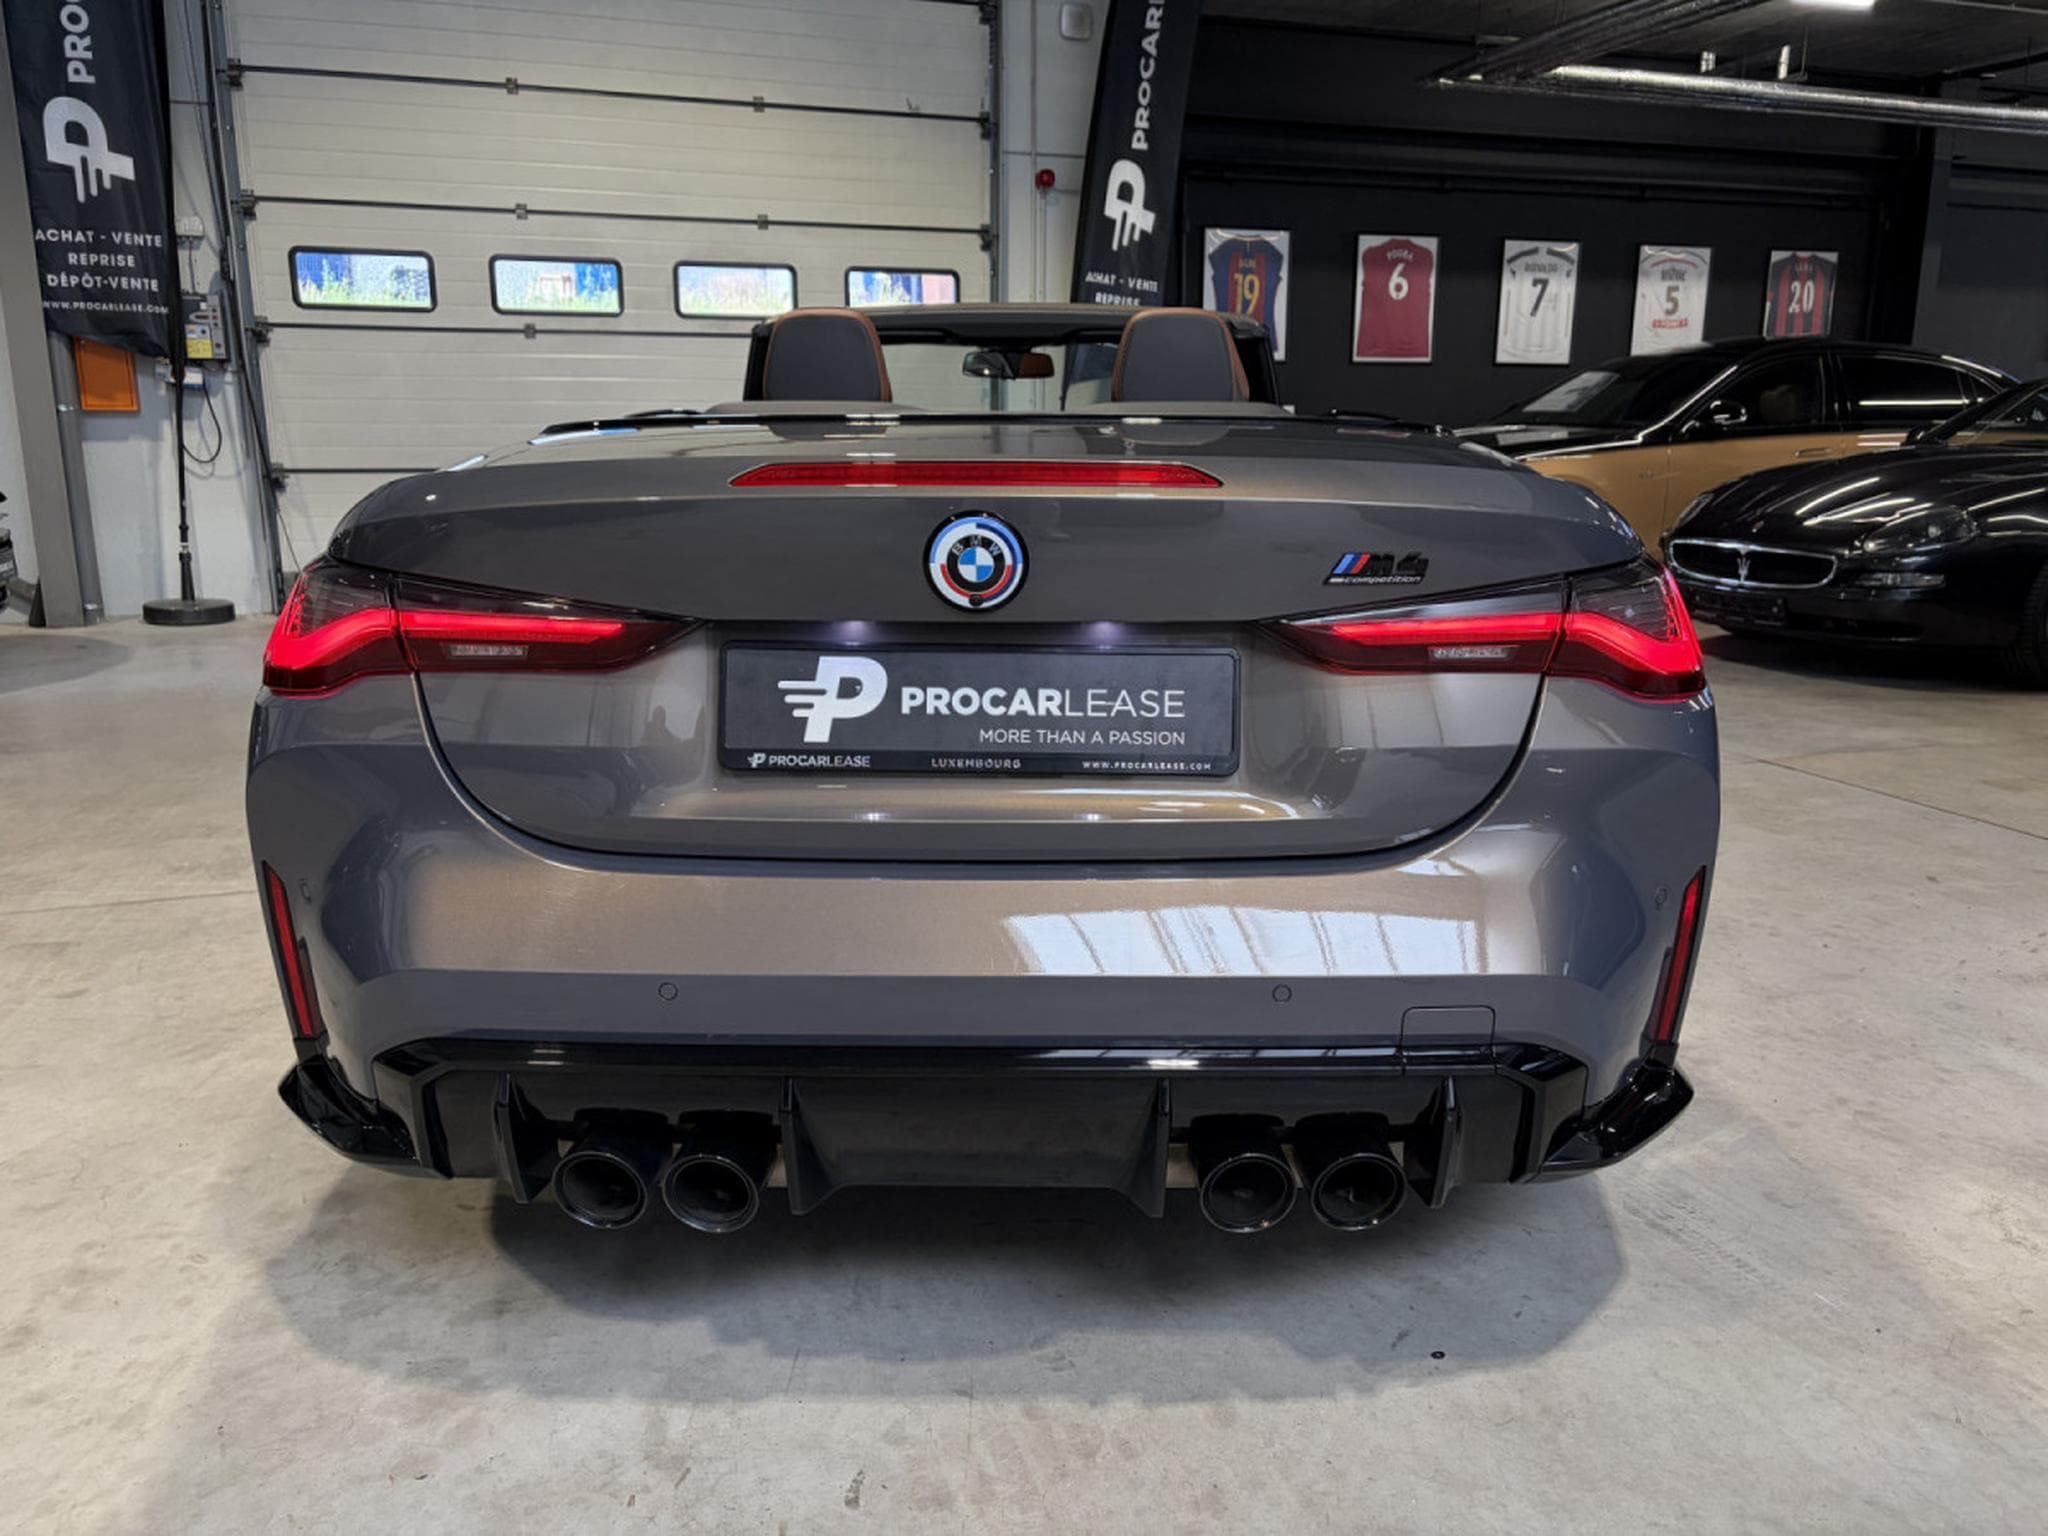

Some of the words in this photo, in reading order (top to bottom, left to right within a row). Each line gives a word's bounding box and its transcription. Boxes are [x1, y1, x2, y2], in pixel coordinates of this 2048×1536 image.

[60, 0, 96, 84] PRO
[35, 229, 94, 243] ACHAT
[111, 231, 162, 247] VENTE
[68, 252, 135, 268] REPRISE
[1085, 271, 1116, 286] ACHAT
[1388, 262, 1409, 300] 6
[1233, 272, 1260, 318] 19
[1530, 278, 1549, 317] 7
[1665, 285, 1680, 316] 5
[1788, 280, 1815, 314] 20
[951, 535, 1002, 557] BMW
[901, 687, 1186, 718] PROCARLEASE
[979, 729, 1031, 744] MORE
[1036, 730, 1086, 744] THAN
[1090, 731, 1104, 744] A
[1108, 731, 1186, 745] PASSION
[768, 755, 871, 768] PROCARLEASE
[931, 758, 1022, 769] LUXEMBOURG
